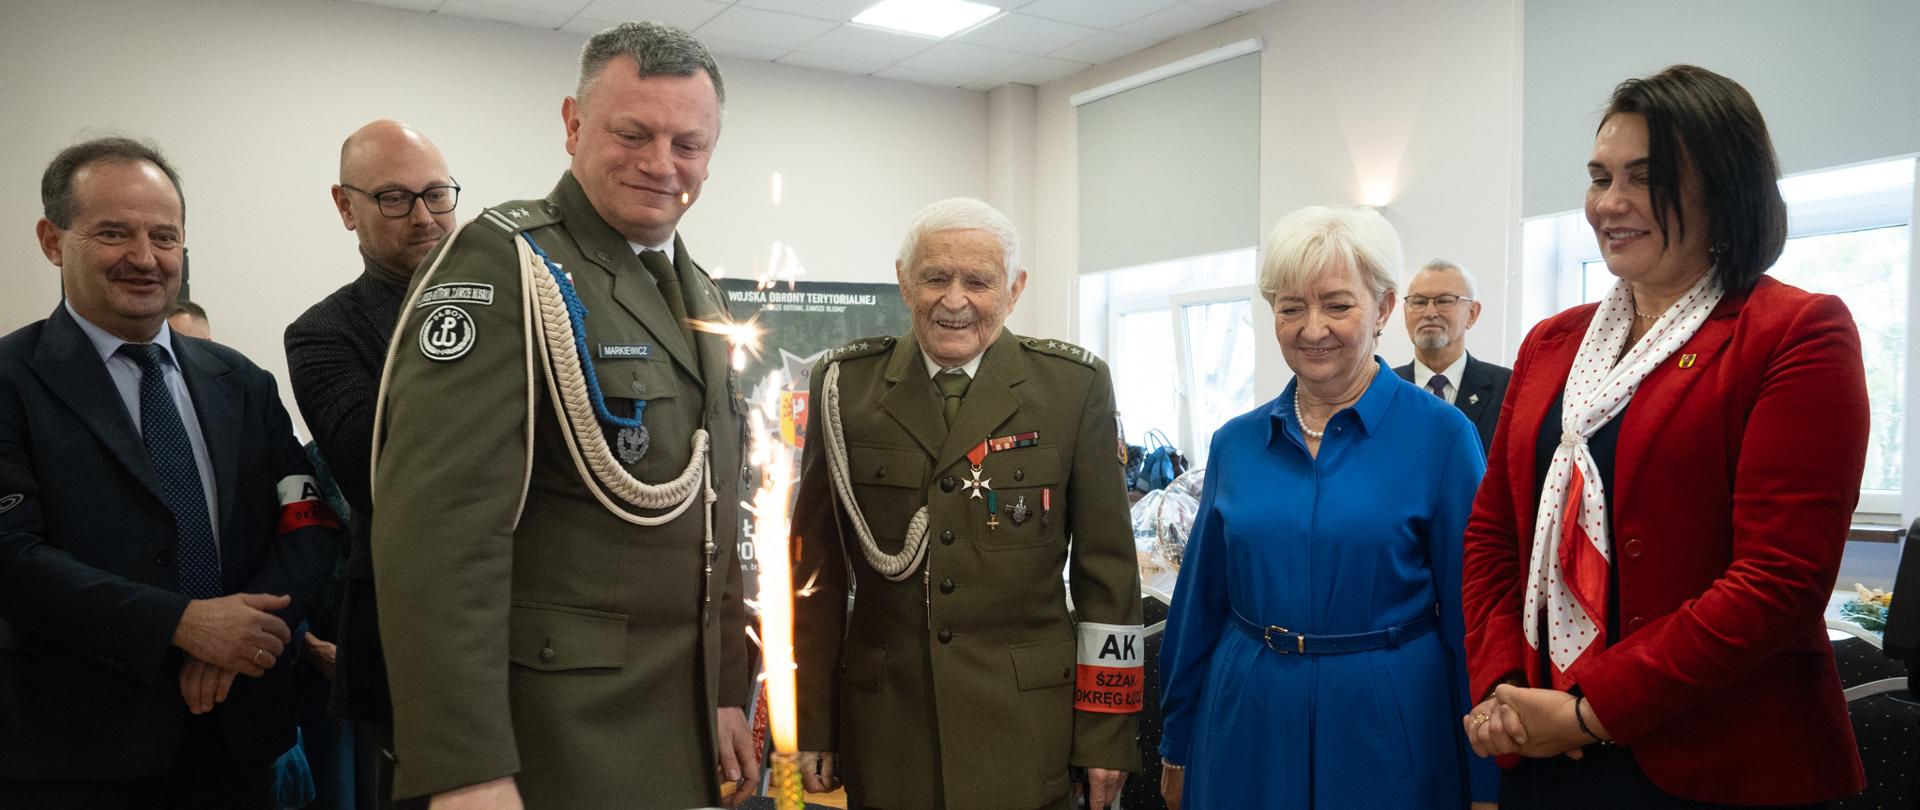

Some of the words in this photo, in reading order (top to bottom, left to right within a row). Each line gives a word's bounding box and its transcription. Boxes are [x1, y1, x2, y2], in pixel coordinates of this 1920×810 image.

[729, 291, 766, 303] WOJSKA
[769, 292, 805, 303] OBRONY
[807, 294, 876, 305] TERYTORIALNEJ
[604, 346, 648, 355] MARKIEWICZ
[301, 482, 320, 500] A
[1099, 634, 1136, 660] AK
[1076, 690, 1122, 708] OKRĘG
